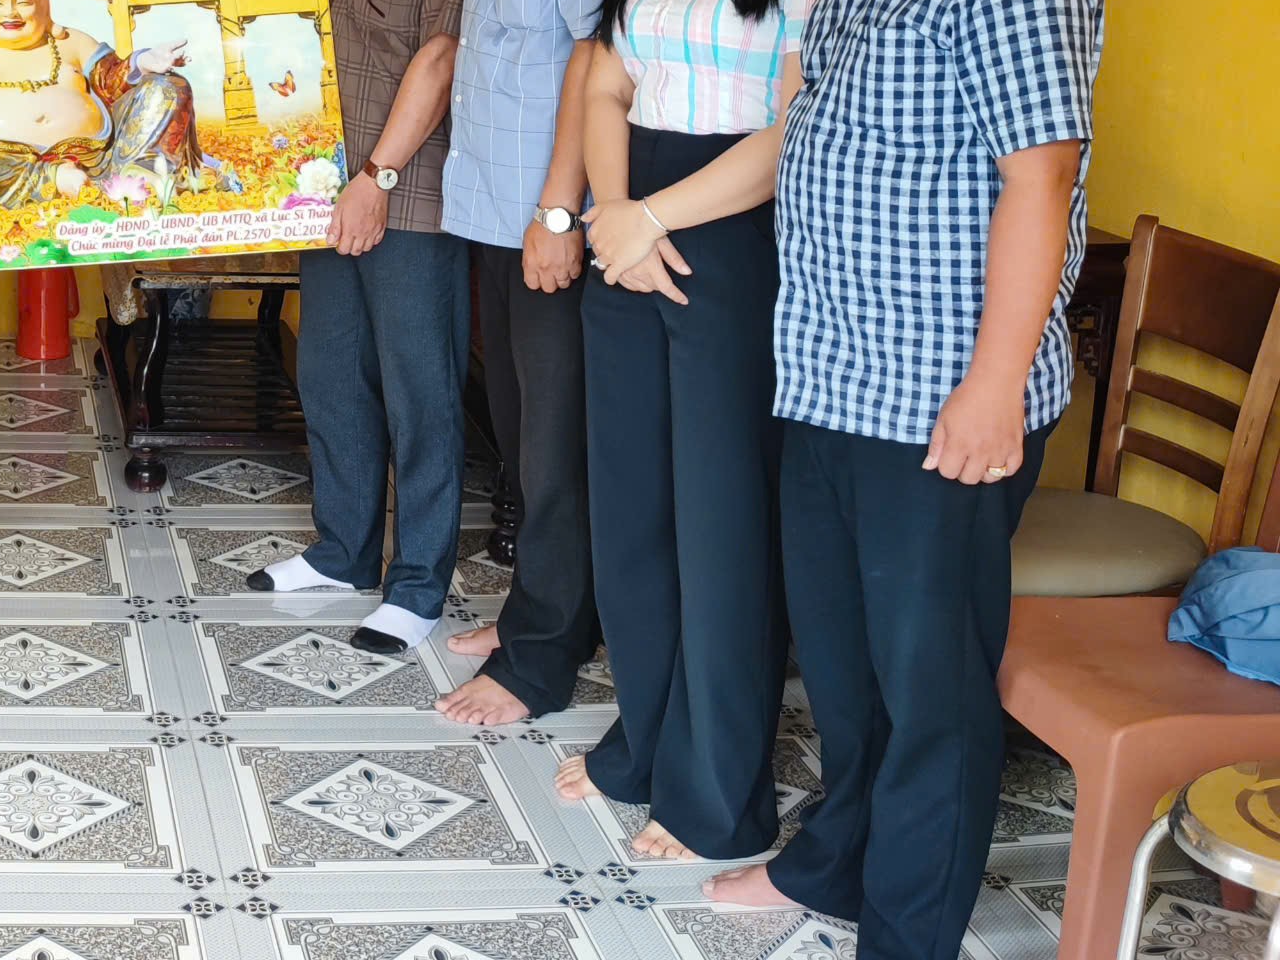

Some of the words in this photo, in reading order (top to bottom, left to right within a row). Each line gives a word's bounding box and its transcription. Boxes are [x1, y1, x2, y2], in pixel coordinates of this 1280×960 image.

[116, 219, 150, 232] HĐND
[202, 215, 218, 226] UB
[221, 213, 252, 225] MTTQ
[255, 212, 268, 222] xã
[308, 208, 332, 219] Thàn
